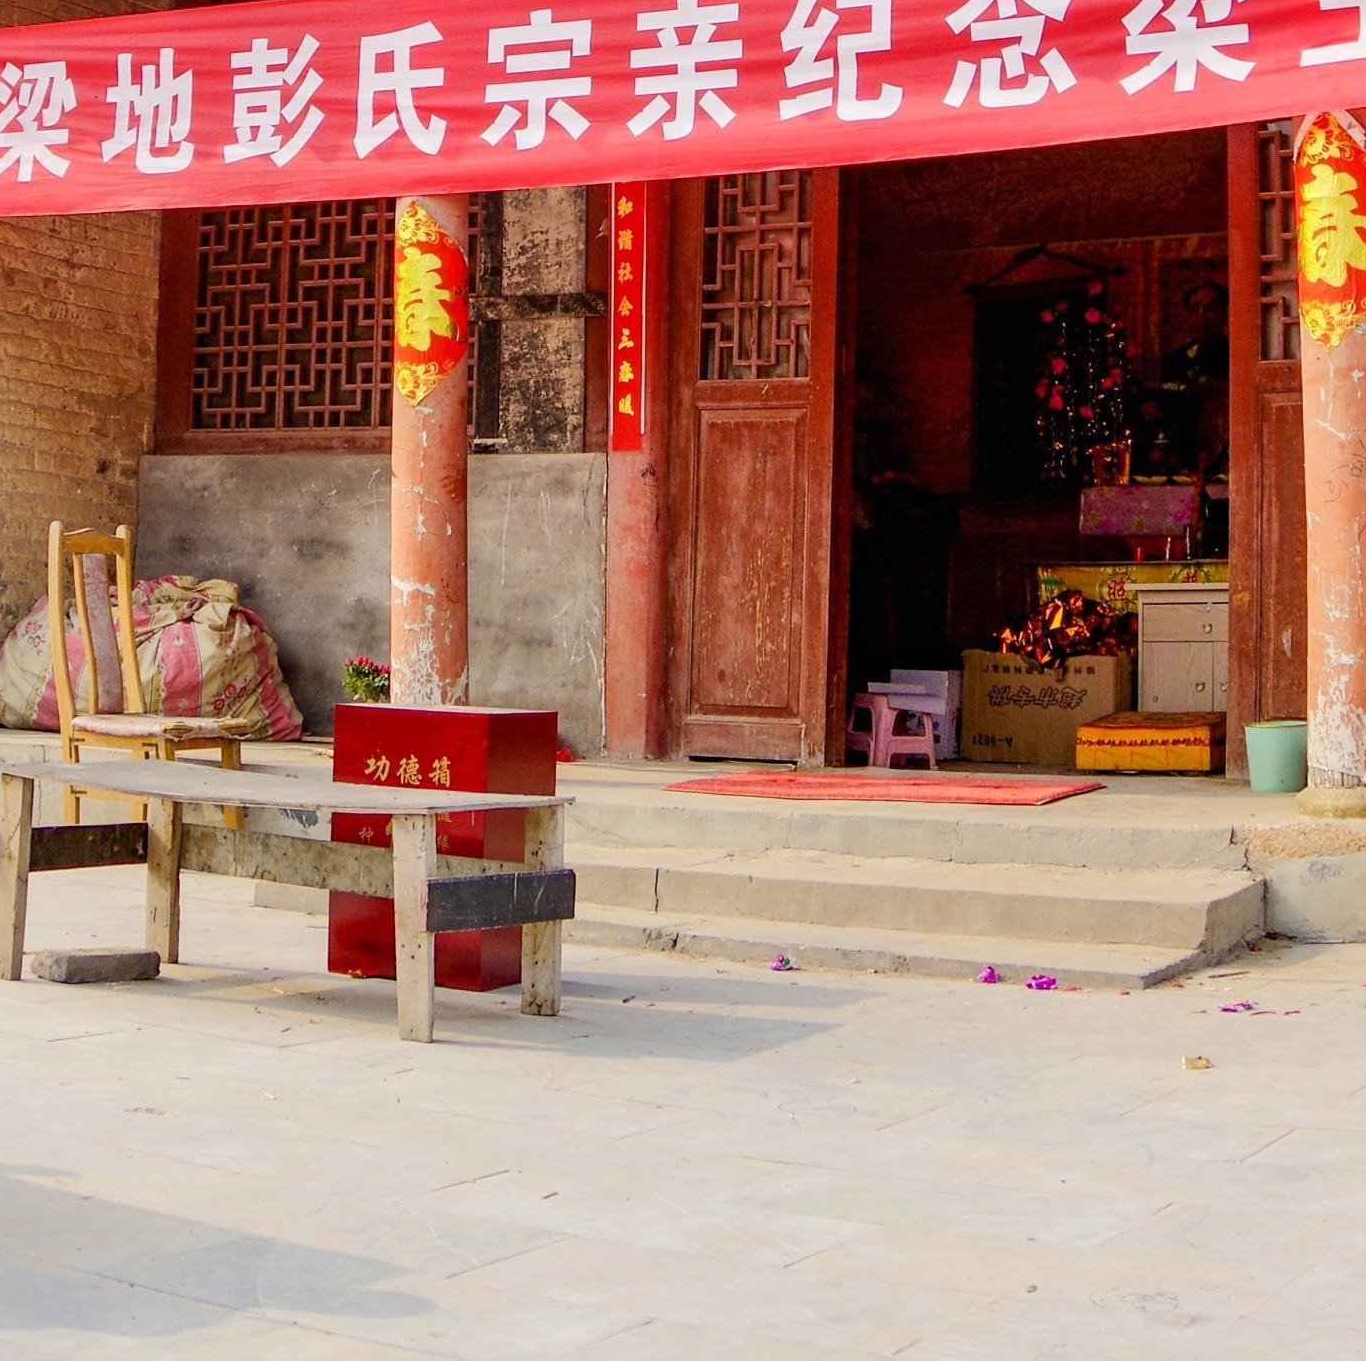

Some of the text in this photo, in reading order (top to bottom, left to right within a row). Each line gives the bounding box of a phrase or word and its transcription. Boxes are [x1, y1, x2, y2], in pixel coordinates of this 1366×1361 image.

[397, 247, 457, 351] 春
[617, 196, 635, 415] 和谐社会三春暖
[989, 685, 1087, 709] 超市专供
[364, 755, 451, 787] 功德箱
